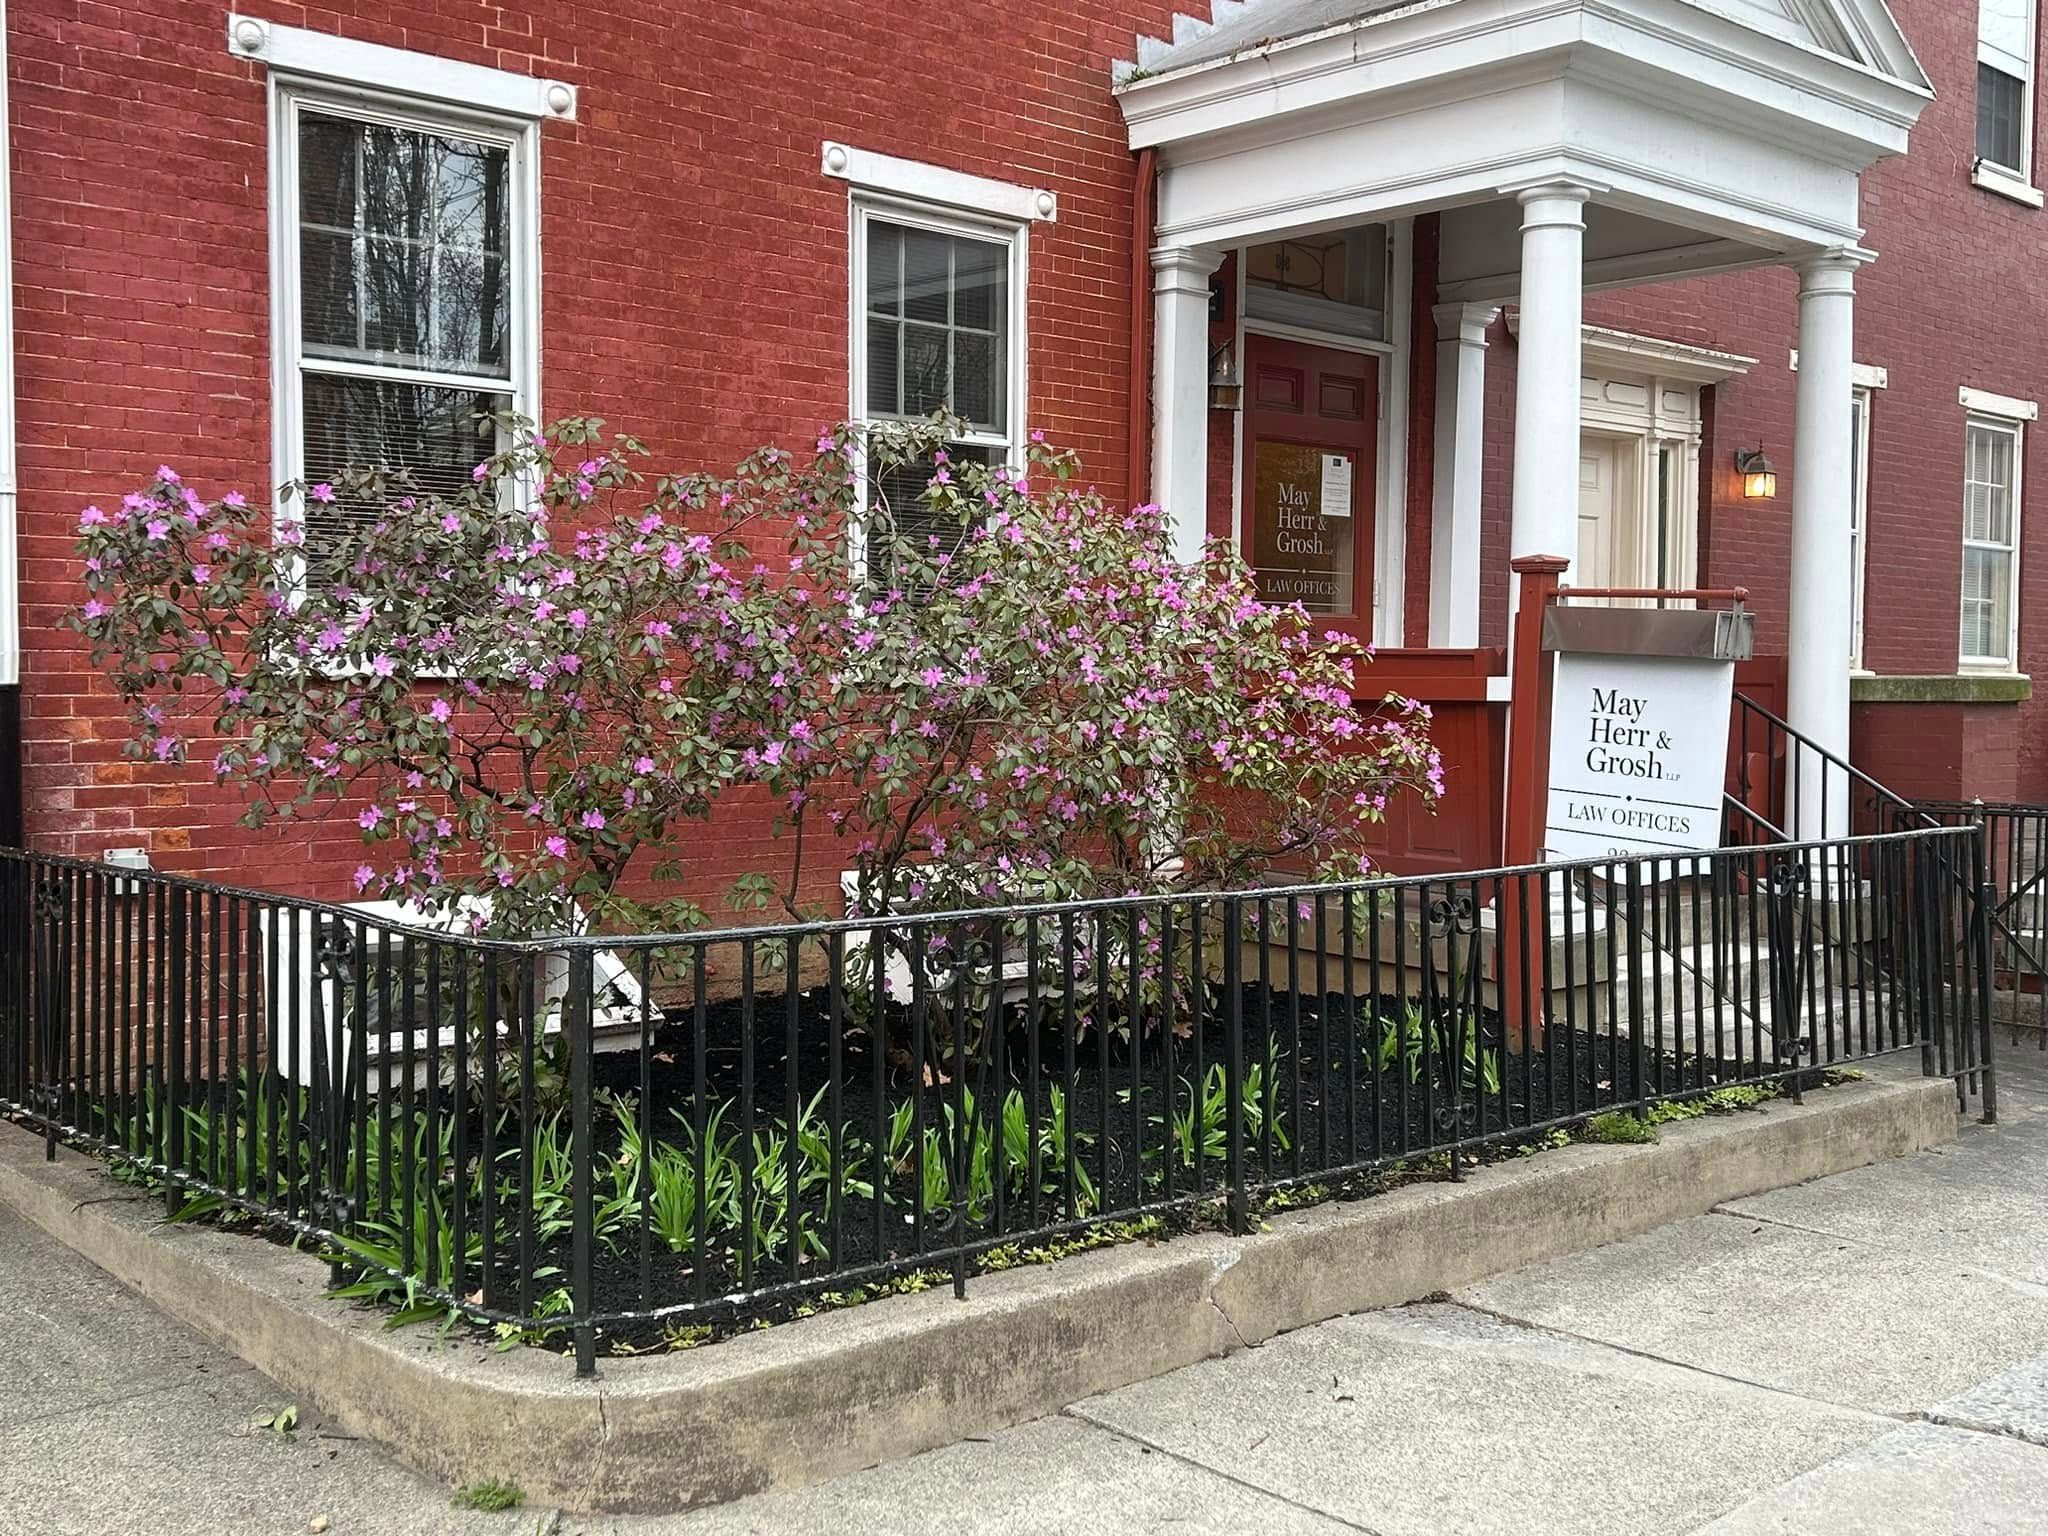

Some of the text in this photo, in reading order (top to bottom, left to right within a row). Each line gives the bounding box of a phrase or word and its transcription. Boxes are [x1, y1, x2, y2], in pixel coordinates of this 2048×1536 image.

[1277, 482, 1312, 511] May
[1277, 507, 1328, 531] Herr &
[1276, 531, 1323, 554] Grosh
[1266, 579, 1341, 595] LAW OFFICES
[1590, 688, 1648, 724] May
[1588, 717, 1673, 750] Herr &
[1586, 747, 1662, 780] Grosh
[1567, 803, 1691, 834] LAW OFFICES
